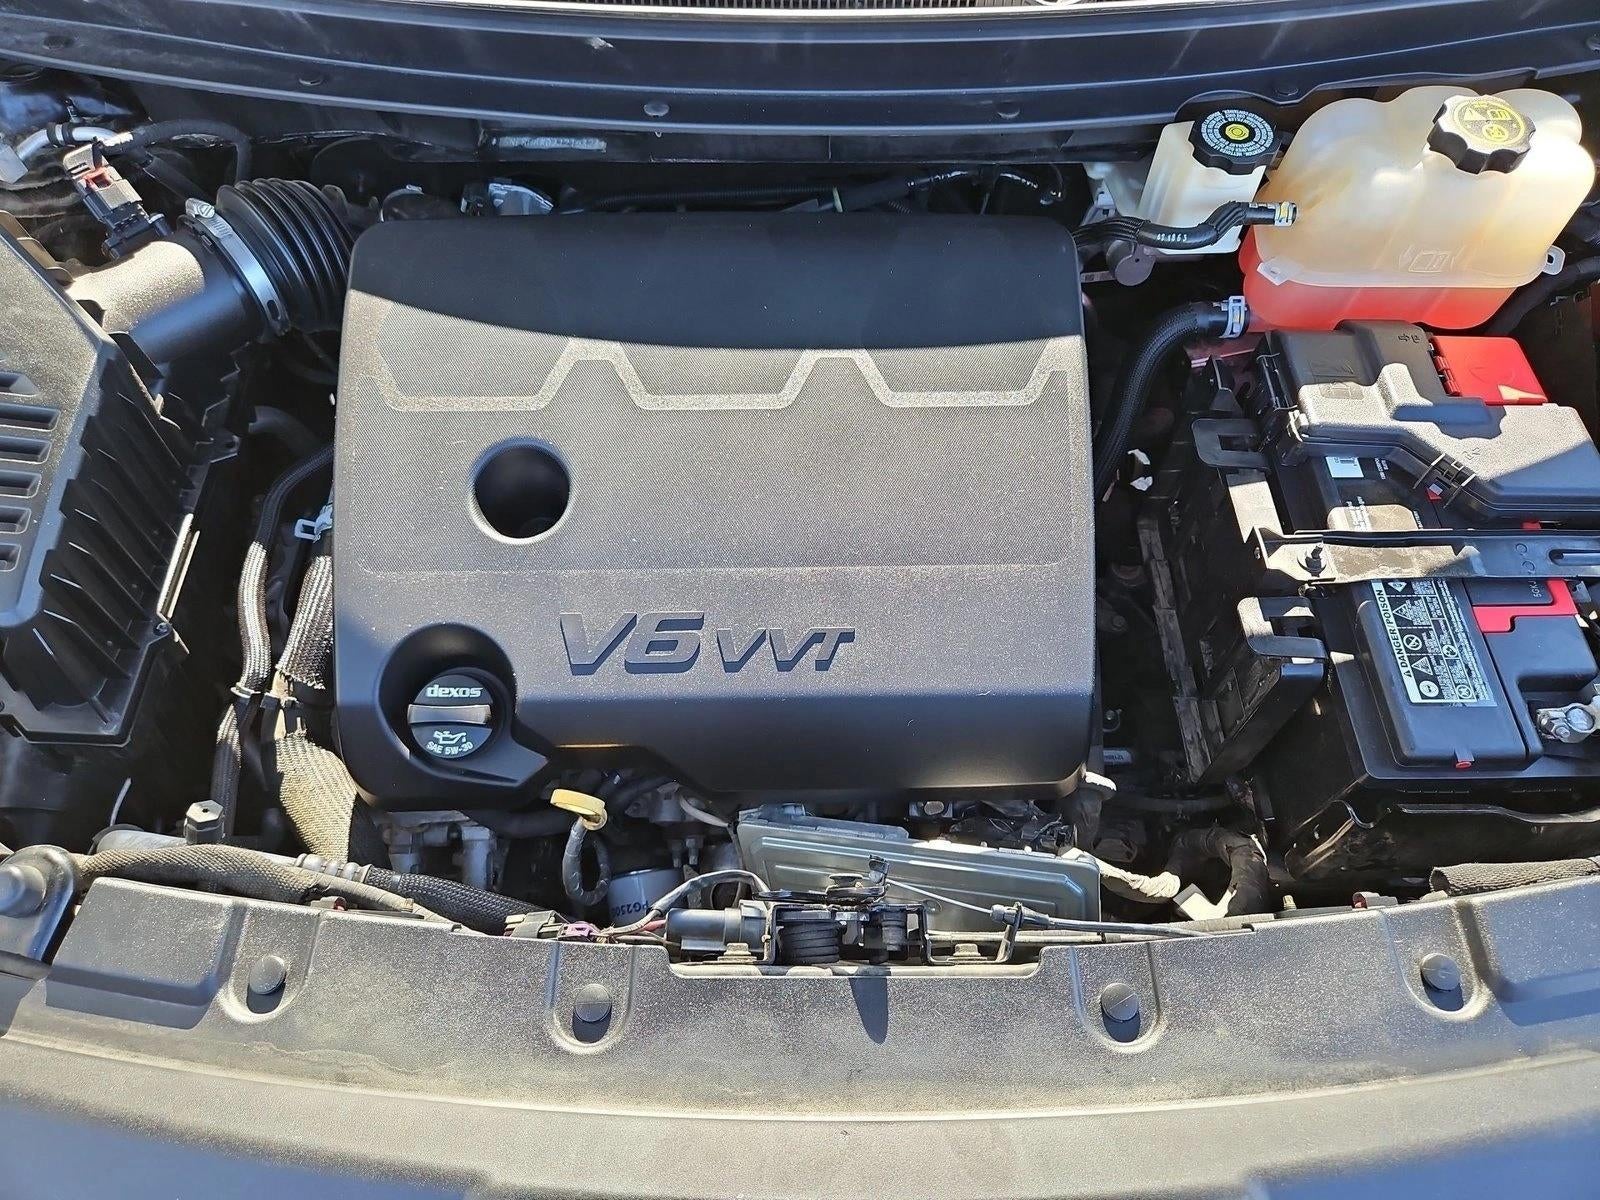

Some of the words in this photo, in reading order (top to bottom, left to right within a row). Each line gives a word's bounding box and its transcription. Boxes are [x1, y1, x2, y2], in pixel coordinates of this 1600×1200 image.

[560, 611, 704, 676] V6
[716, 627, 855, 673] VVT
[426, 684, 483, 698] dexos
[426, 741, 443, 754] SAE
[444, 741, 474, 755] 5W-30
